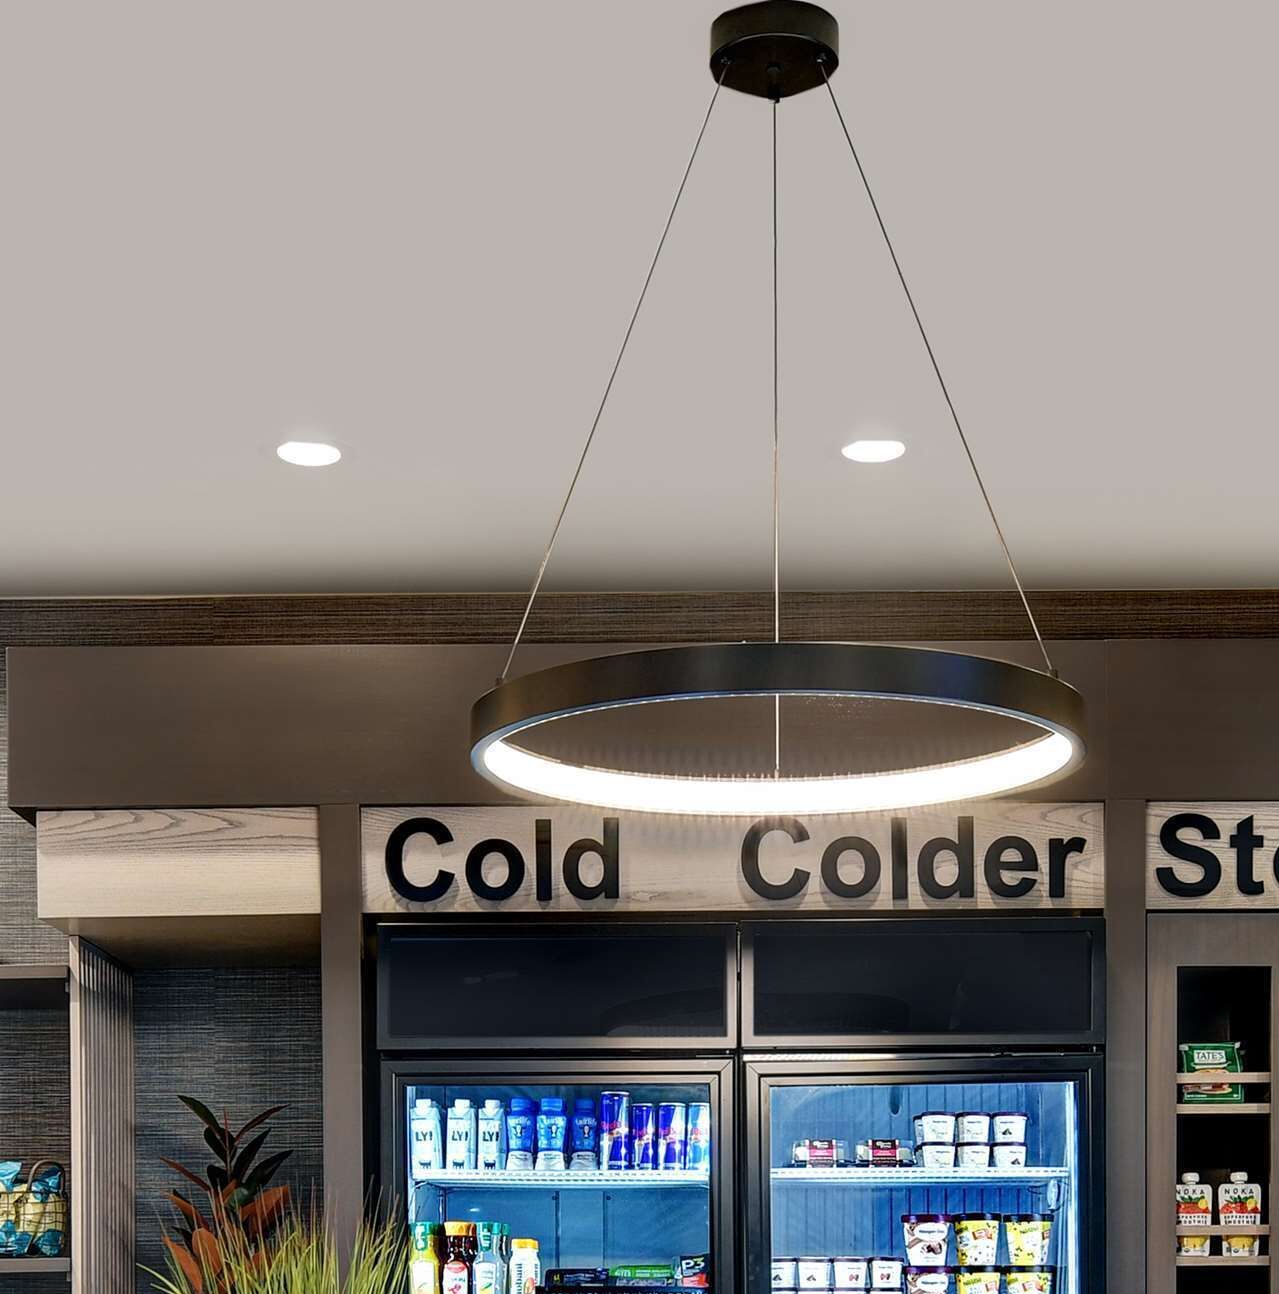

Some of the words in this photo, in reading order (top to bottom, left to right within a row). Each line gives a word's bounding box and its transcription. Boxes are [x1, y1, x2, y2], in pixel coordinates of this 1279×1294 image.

[385, 817, 620, 901] Cold
[740, 815, 1088, 900] Colder
[682, 1256, 705, 1272] P3
